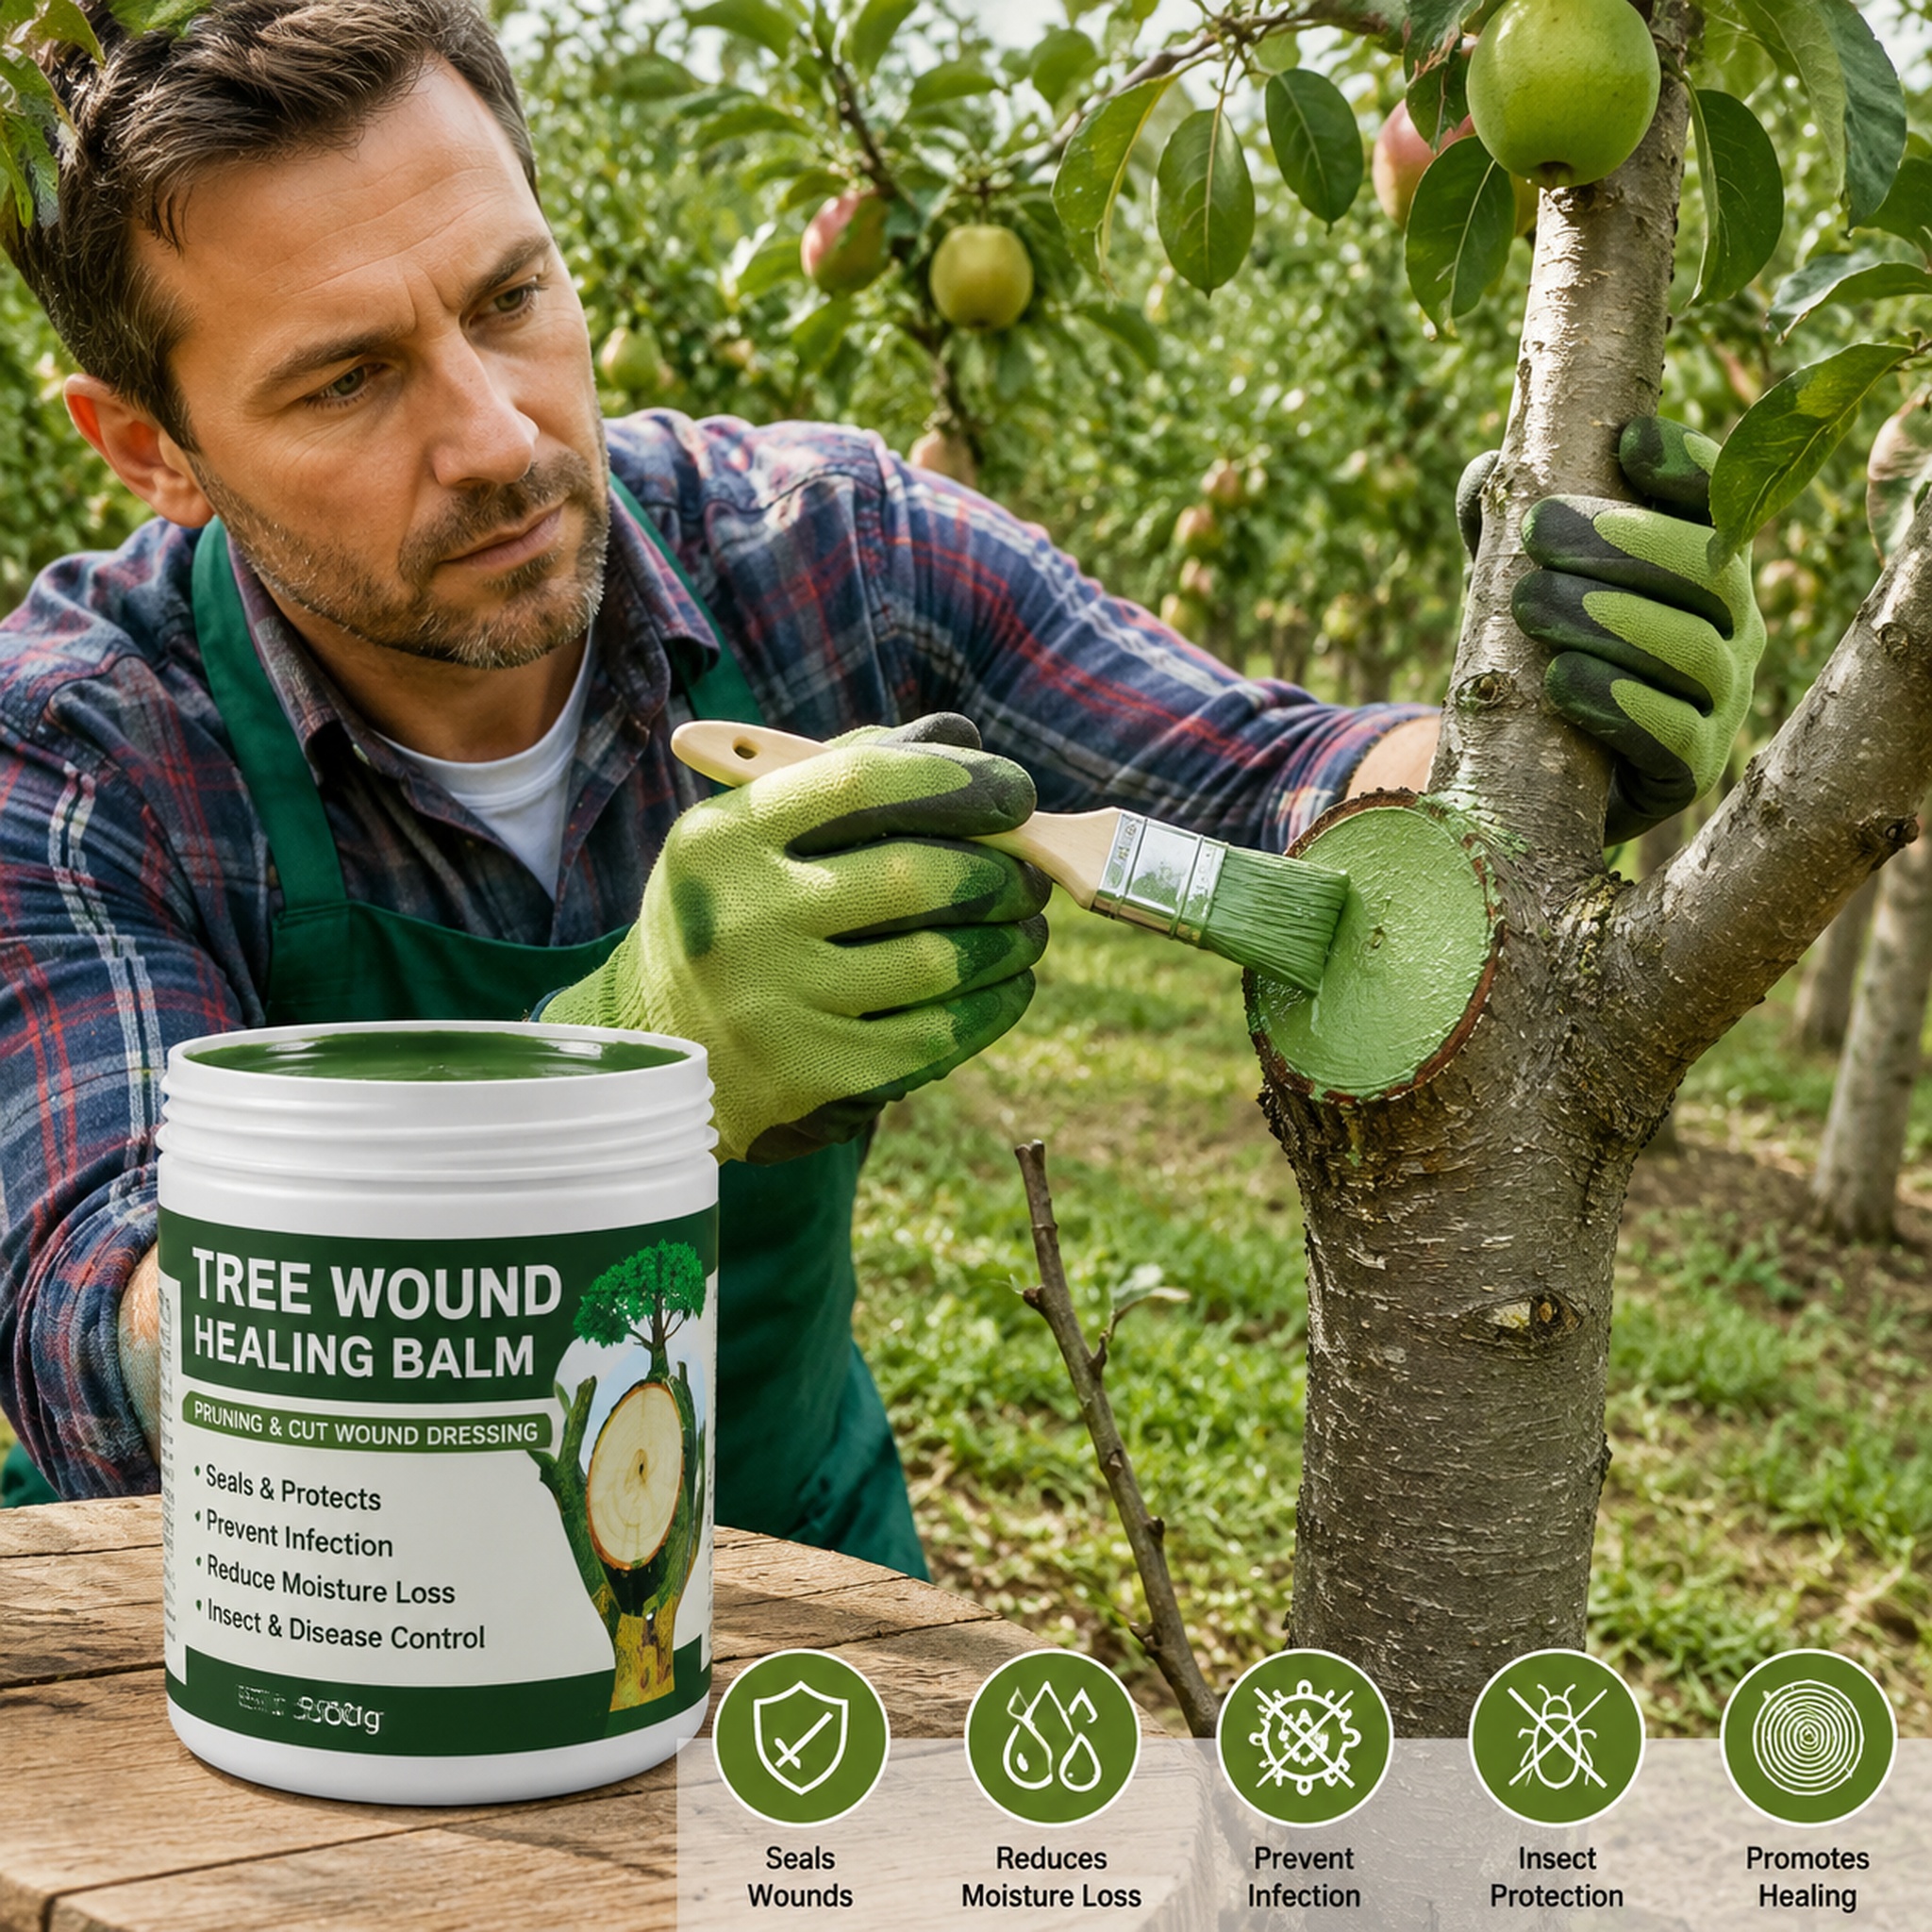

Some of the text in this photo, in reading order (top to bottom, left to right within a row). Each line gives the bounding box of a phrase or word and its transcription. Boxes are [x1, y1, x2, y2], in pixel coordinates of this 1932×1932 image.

[192, 1246, 562, 1321] TREE WOUND
[194, 1314, 534, 1379] HEALING BALM
[193, 1401, 538, 1445] PRUNING & CUT WOUND DRESSING
[206, 1463, 381, 1511] Seals & Protects
[207, 1508, 393, 1557] Prevent Infection
[208, 1553, 456, 1605] Reduce Moisture Loss
[208, 1598, 485, 1650] Insect & Disease Control
